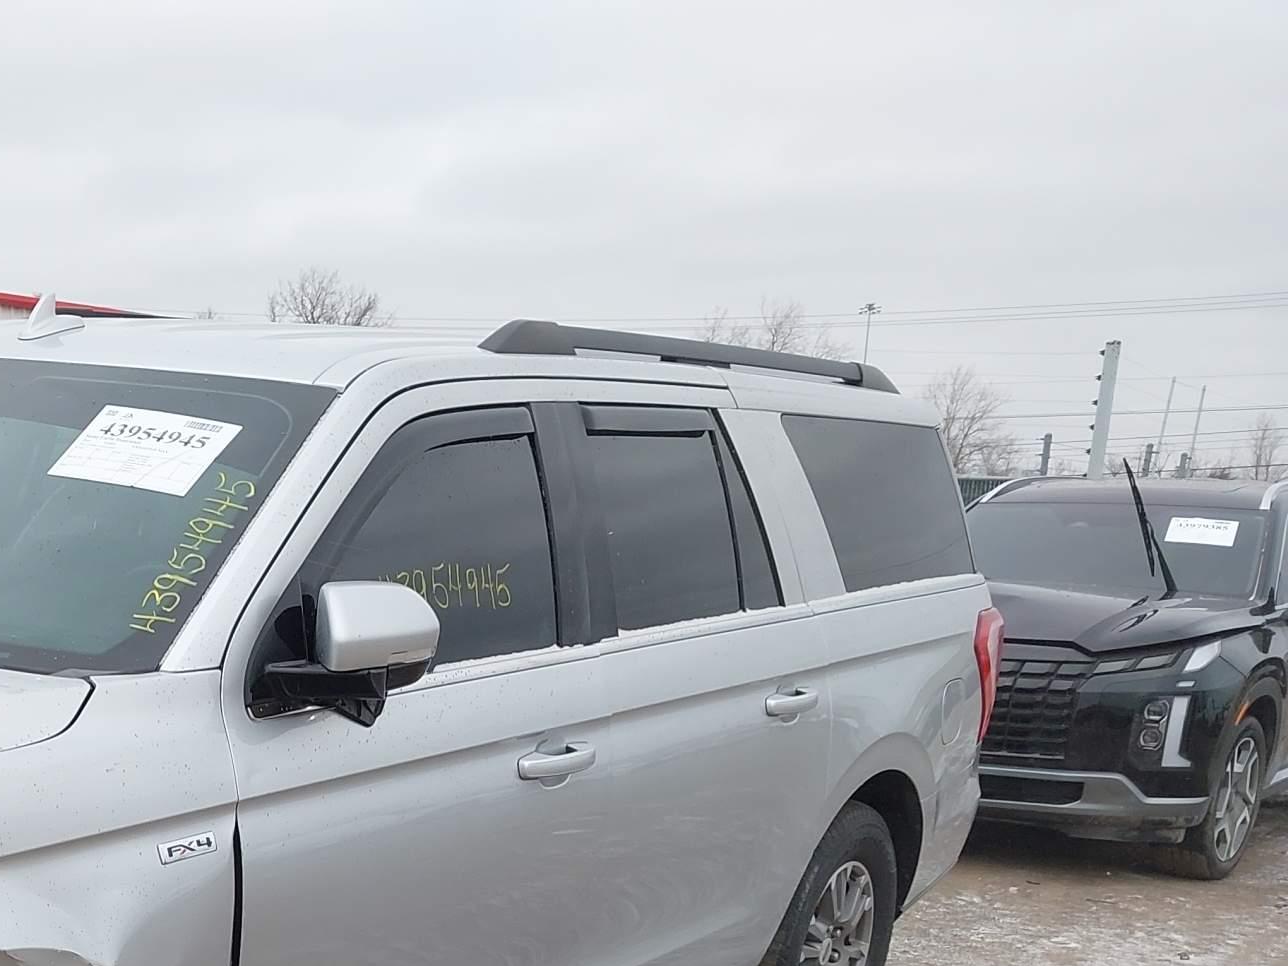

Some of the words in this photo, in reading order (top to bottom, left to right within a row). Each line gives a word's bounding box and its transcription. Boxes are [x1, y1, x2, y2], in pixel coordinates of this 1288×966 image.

[100, 422, 211, 449] 43954945
[128, 471, 256, 634] 43954945
[378, 563, 511, 609] 954945
[166, 836, 213, 858] FX4
